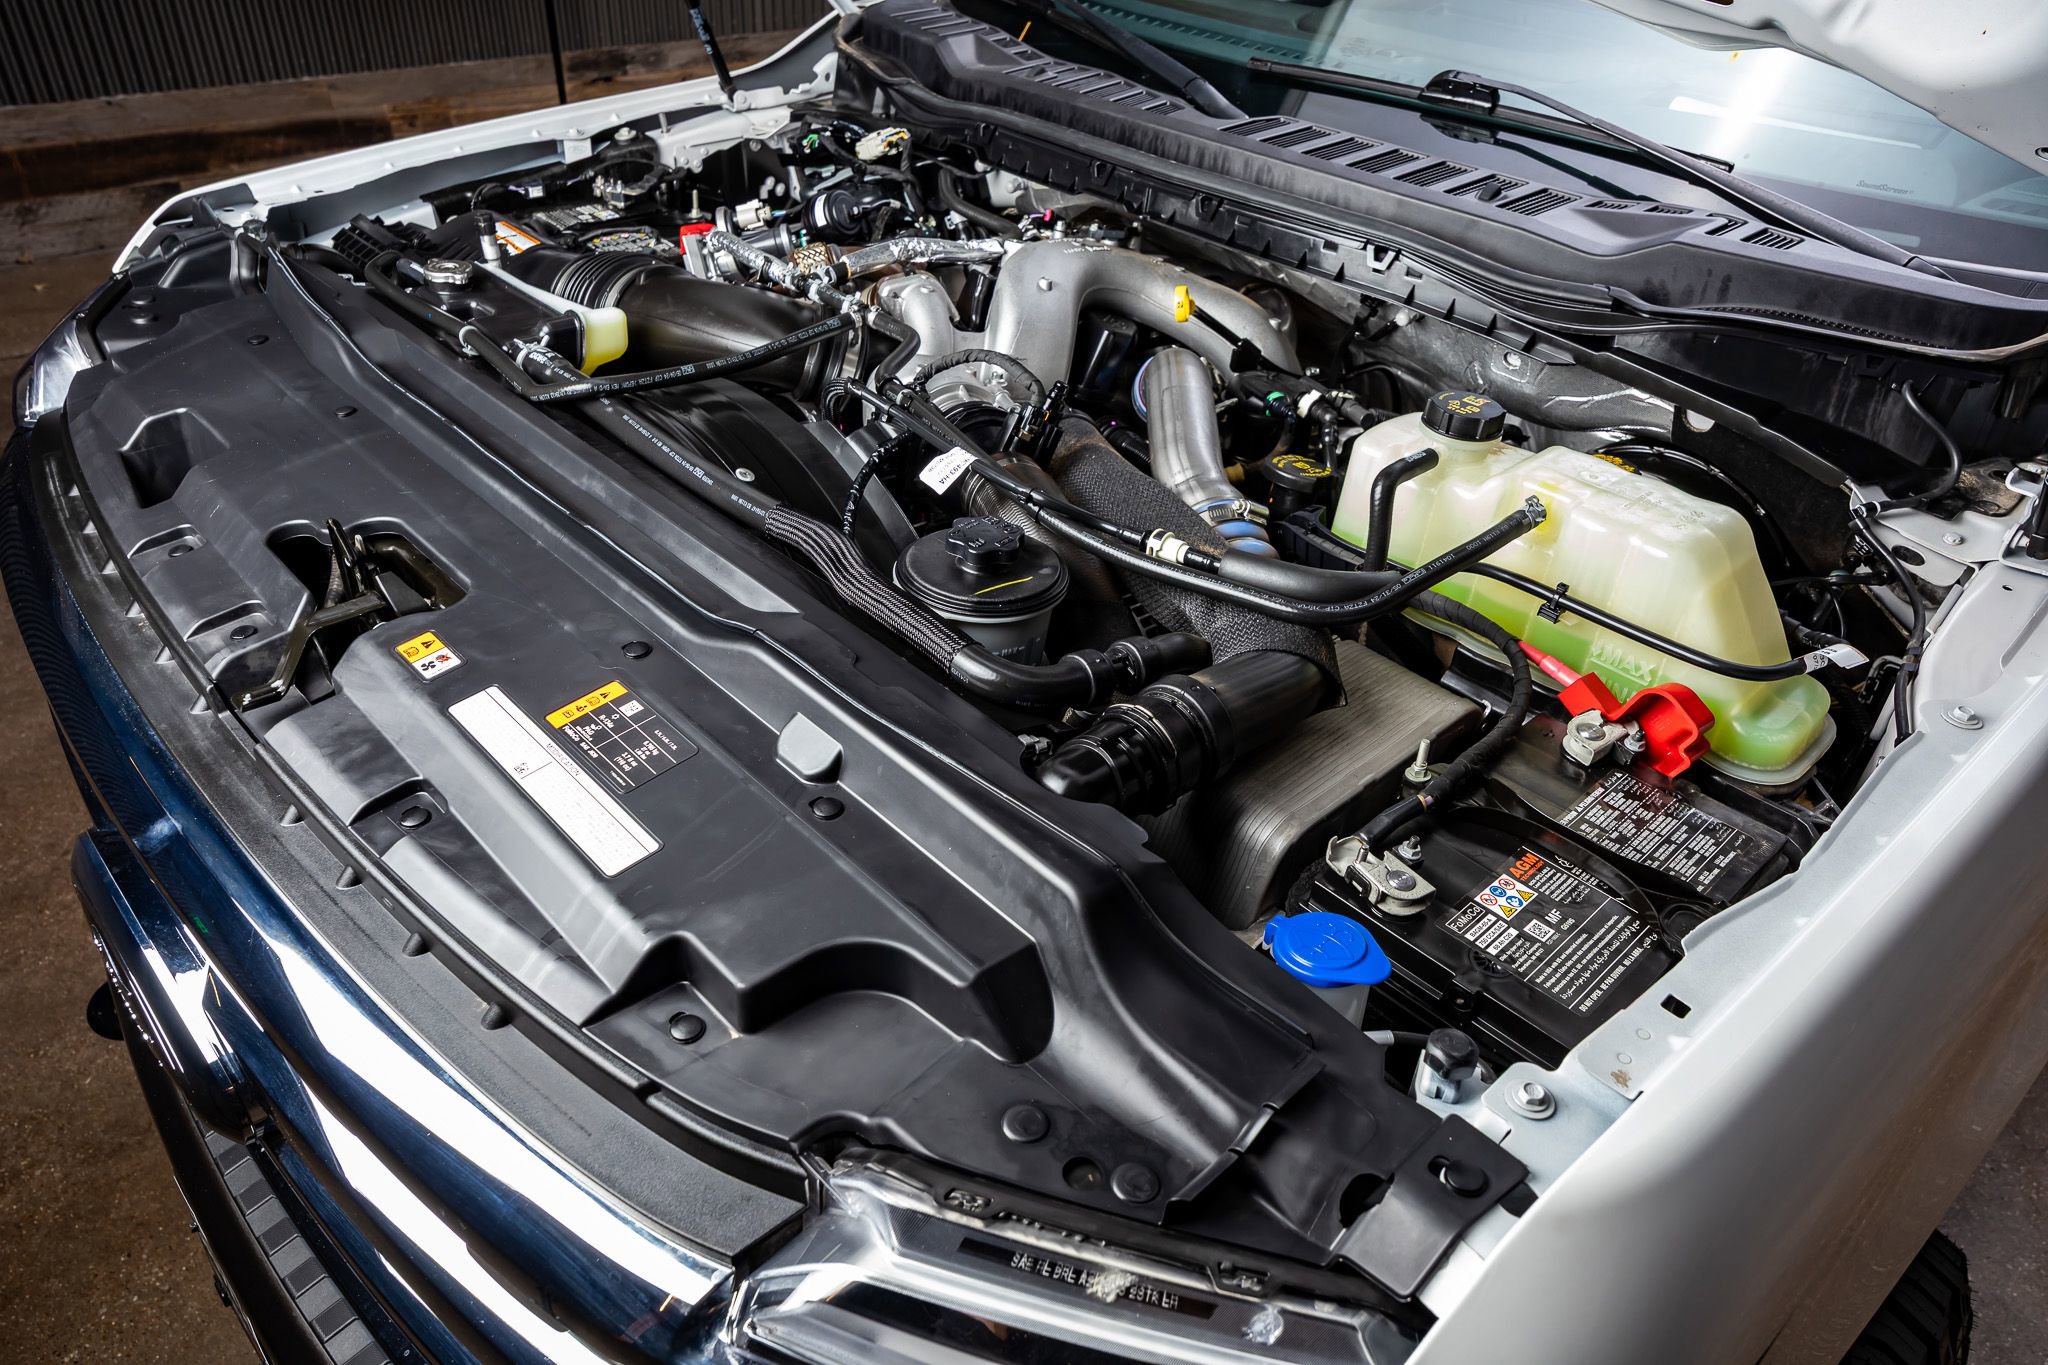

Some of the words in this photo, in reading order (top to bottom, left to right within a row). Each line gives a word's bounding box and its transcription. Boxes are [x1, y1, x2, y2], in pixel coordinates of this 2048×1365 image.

[1509, 853, 1539, 878] AGM
[1449, 904, 1482, 932] FoMoCo
[1545, 909, 1562, 924] MF
